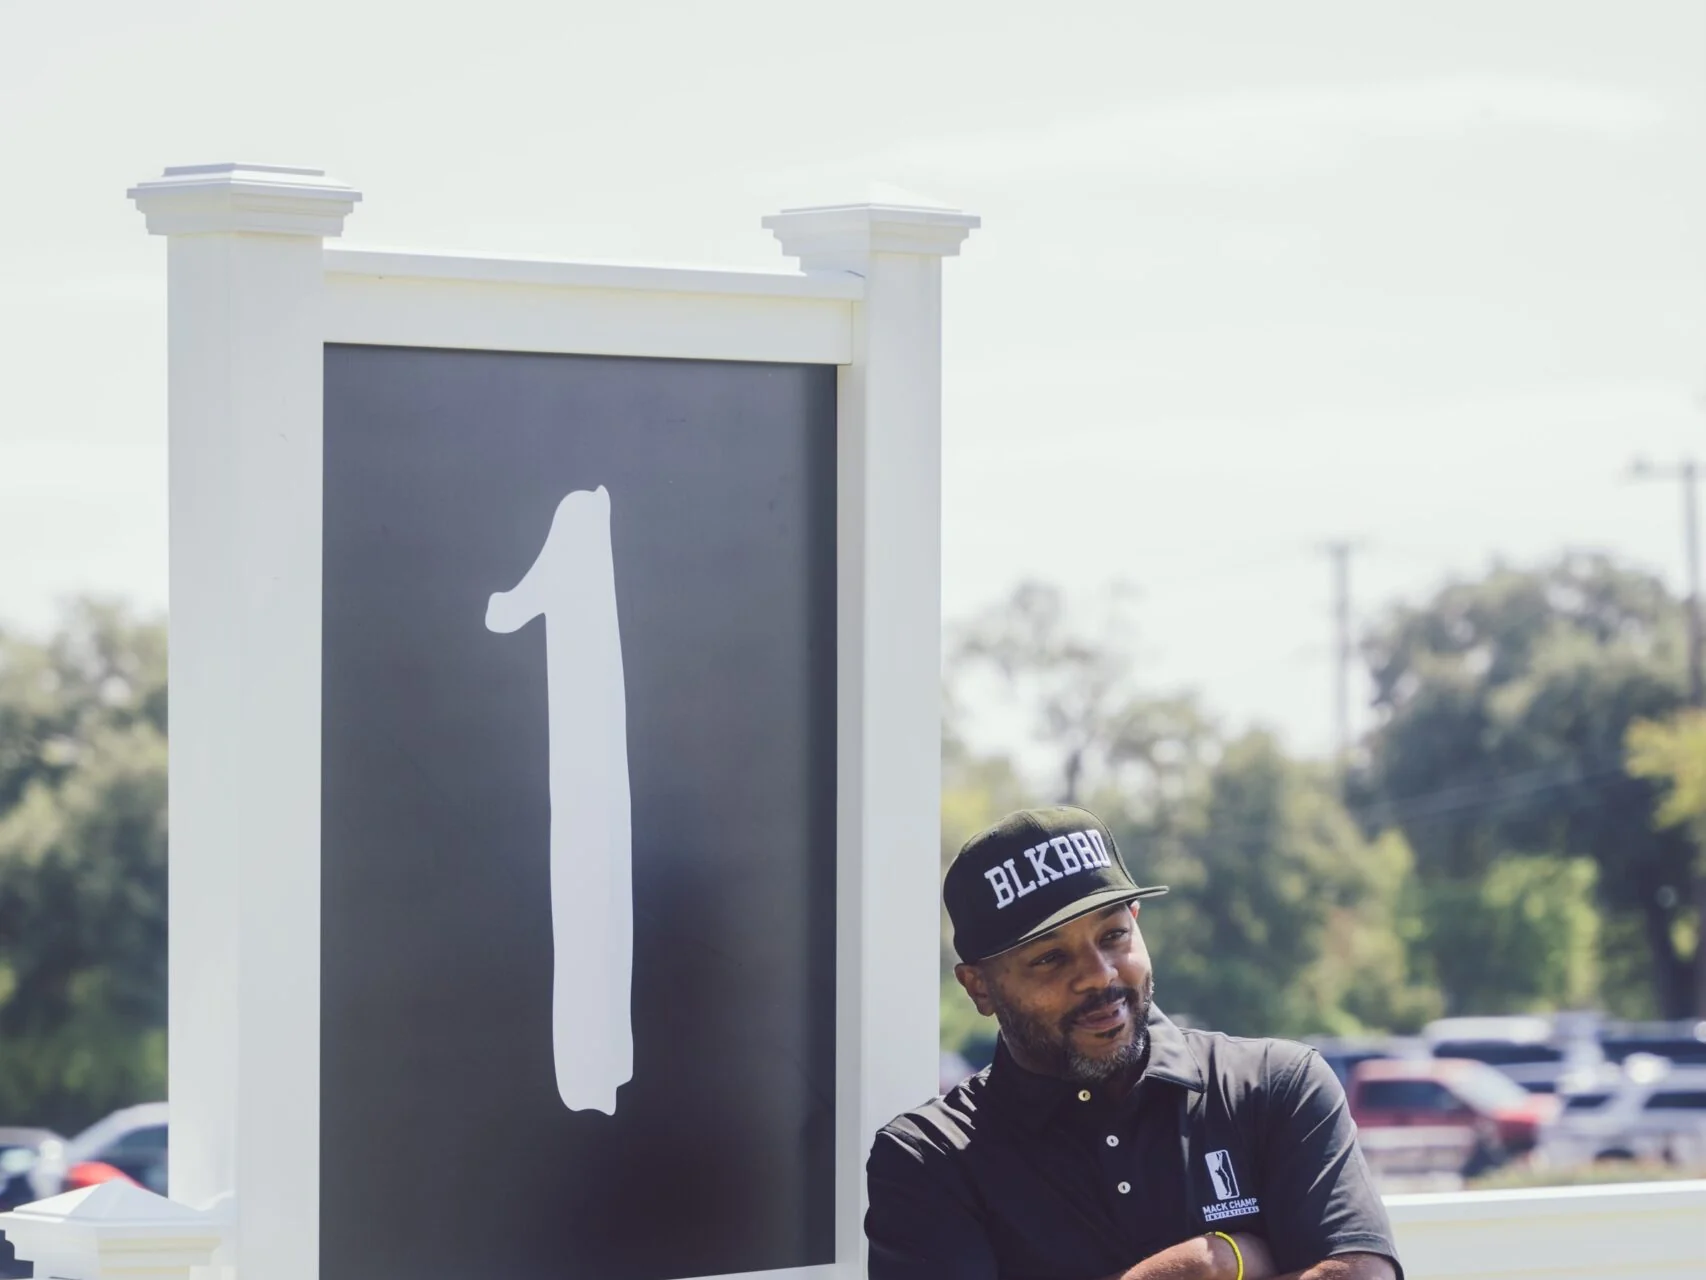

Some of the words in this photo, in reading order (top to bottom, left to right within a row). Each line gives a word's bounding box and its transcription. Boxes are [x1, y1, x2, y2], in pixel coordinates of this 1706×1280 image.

[485, 485, 633, 1116] 1
[984, 829, 1111, 909] BLKBRD
[1202, 1202, 1228, 1215] MACK
[1229, 1198, 1257, 1210] CHAMP
